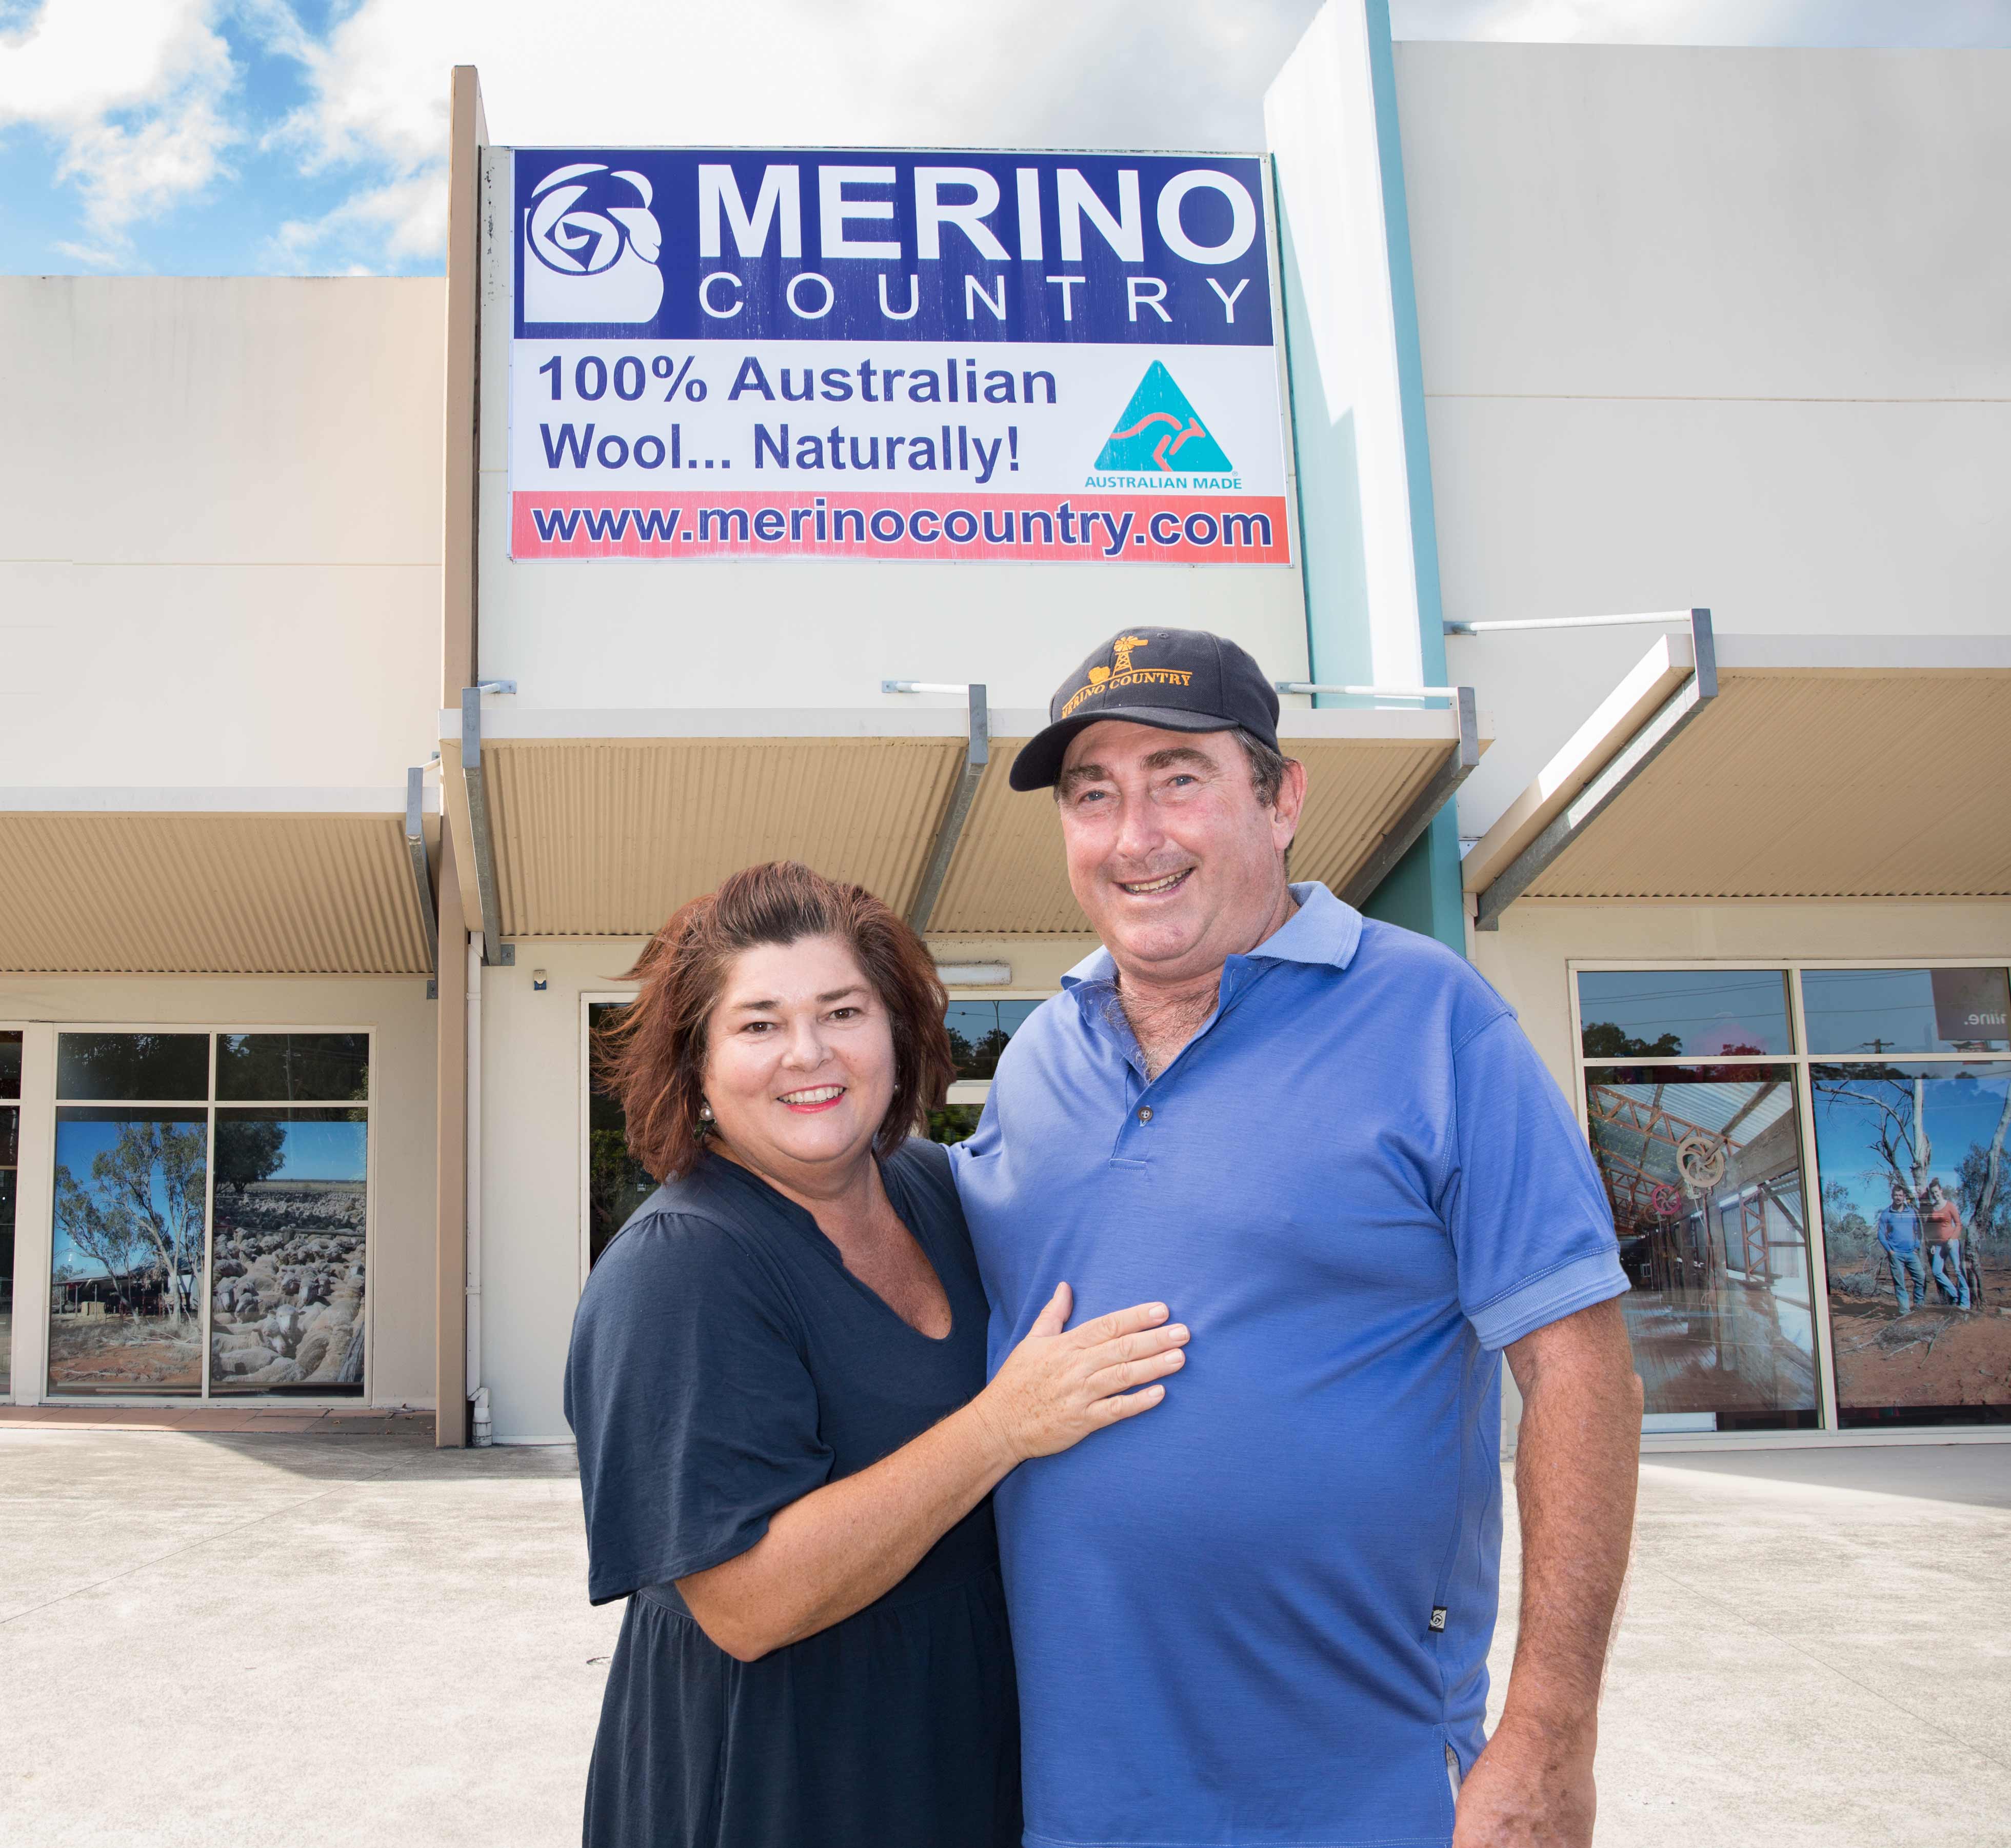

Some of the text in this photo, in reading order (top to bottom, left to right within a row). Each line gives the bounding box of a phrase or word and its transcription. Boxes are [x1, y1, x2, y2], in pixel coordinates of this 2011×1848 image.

[699, 164, 1256, 264] MERINO
[700, 272, 1249, 323] COUNTRY
[540, 356, 1056, 403] 100% Australian
[540, 424, 1018, 483] Wool... Naturally!
[1085, 476, 1242, 489] AUSTRALIAN MADE
[532, 498, 1272, 556] www.merinocountry.com
[1109, 673, 1191, 689] COUNTRY
